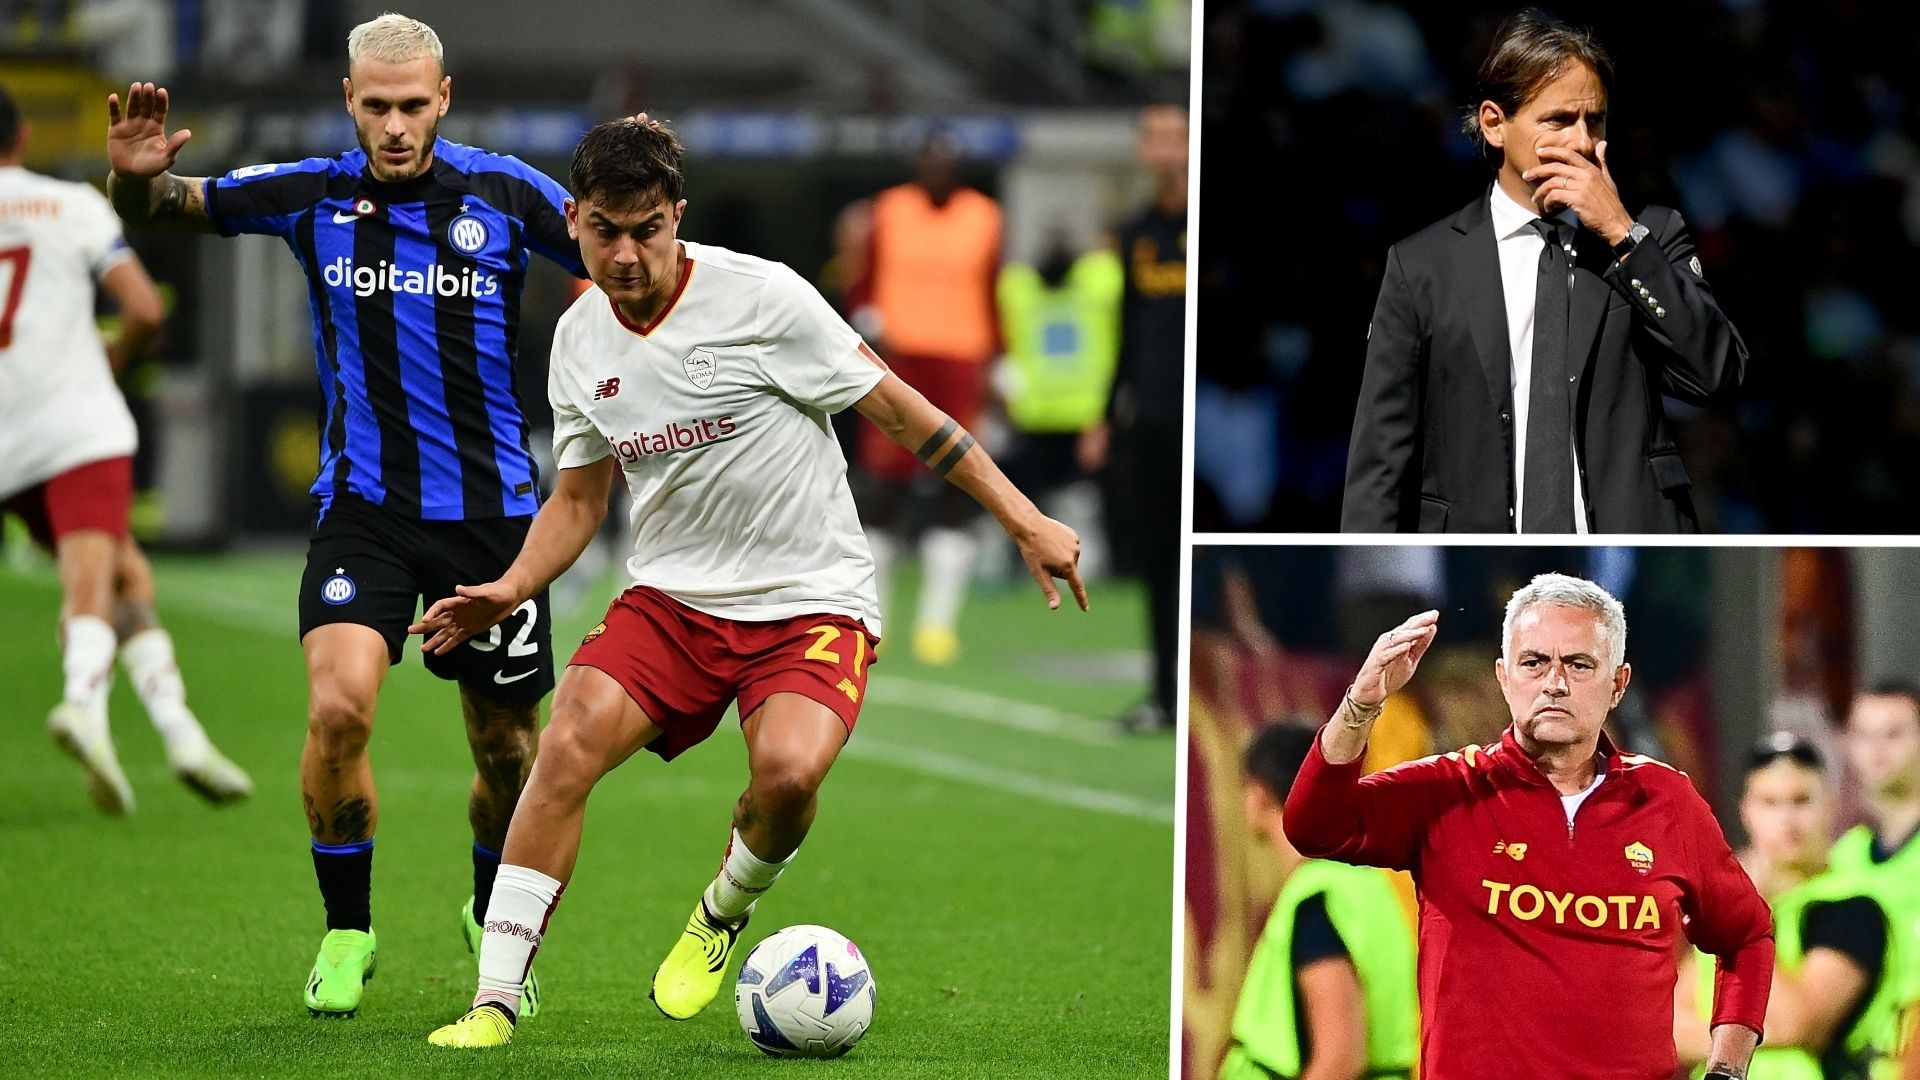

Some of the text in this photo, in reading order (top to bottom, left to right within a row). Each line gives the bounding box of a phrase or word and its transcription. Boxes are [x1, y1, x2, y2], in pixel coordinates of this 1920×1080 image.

[323, 256, 498, 297] digitalbits
[606, 416, 736, 463] igitalbits
[805, 625, 865, 678] 21
[1482, 879, 1661, 930] TOYOTA
[484, 920, 541, 947] ROMA
